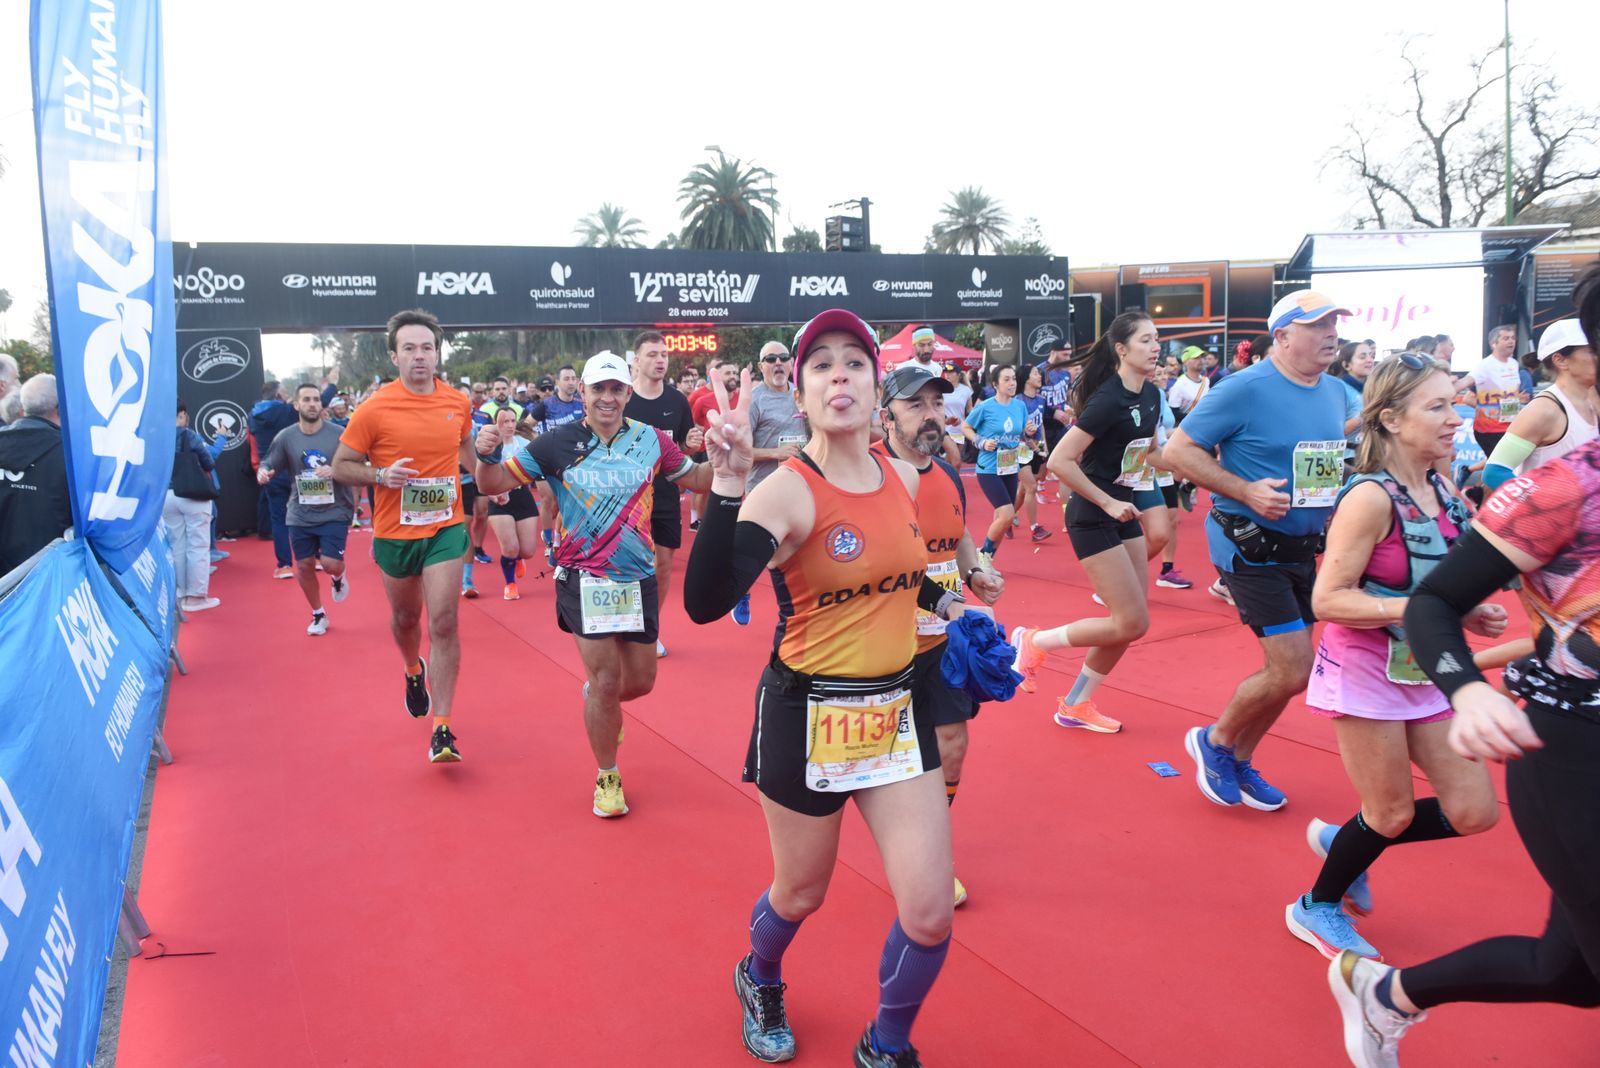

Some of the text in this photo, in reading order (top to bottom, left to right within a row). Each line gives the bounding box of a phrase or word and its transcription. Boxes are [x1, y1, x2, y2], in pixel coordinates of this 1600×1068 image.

[62, 55, 92, 136] FLY
[120, 72, 154, 151] FLY
[312, 276, 376, 287] HYUNDAI
[417, 272, 494, 295] HOKA
[655, 270, 741, 287] maratón
[790, 276, 848, 296] HOKA
[891, 281, 933, 290] HYUNDAI
[312, 289, 354, 297] Hyundauto
[679, 285, 745, 303] sevilla
[668, 308, 679, 316] 28
[707, 308, 729, 316] 2024
[1341, 295, 1430, 332] enfe
[68, 160, 156, 521] HOKA
[302, 481, 325, 491] 9080
[411, 489, 444, 504] 7802
[592, 588, 628, 606] 6261
[55, 577, 119, 707] HOKA
[105, 660, 146, 763] FLY HUMAN FLY
[820, 707, 897, 744] 11134
[45, 889, 77, 985] FLY
